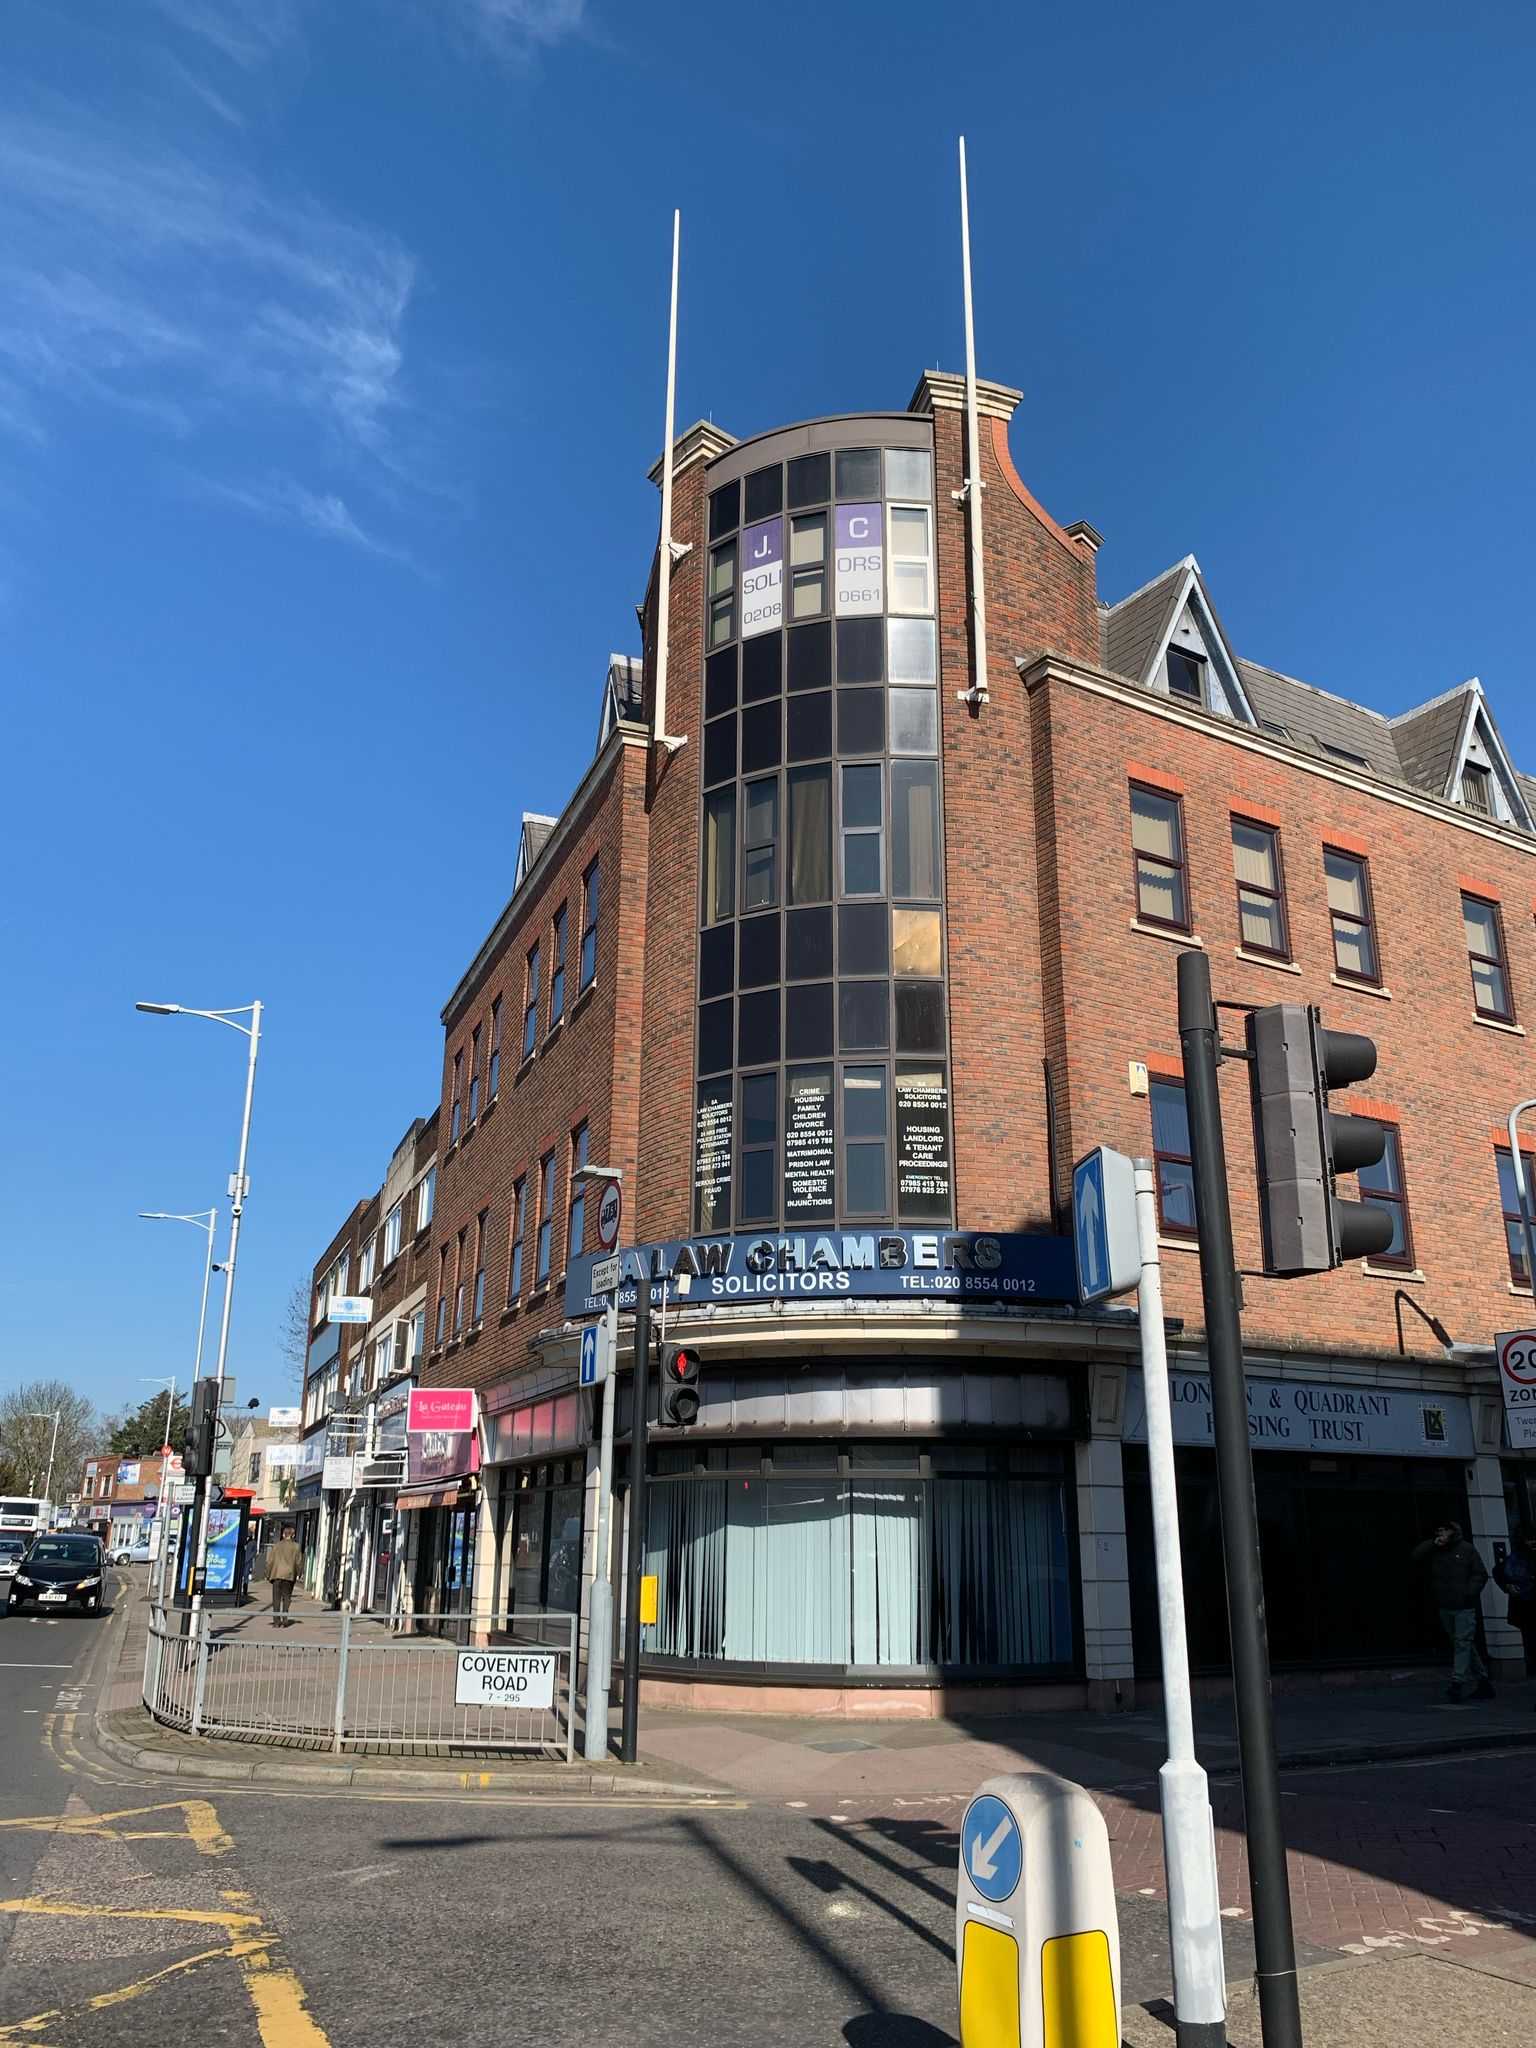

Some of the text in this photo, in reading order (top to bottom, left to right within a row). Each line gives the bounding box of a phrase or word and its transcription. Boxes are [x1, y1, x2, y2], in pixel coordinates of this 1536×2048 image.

[849, 517, 868, 538] C
[754, 535, 772, 558] J.
[837, 555, 881, 573] ORS
[742, 588, 880, 625] 0208 0661
[797, 1104, 821, 1112] FAMILY
[792, 1112, 826, 1120] CHILDREN
[794, 1121, 825, 1129] DIVORCE
[906, 1125, 940, 1133] HOUSING
[800, 1130, 816, 1138] 8554
[816, 1129, 833, 1137] 0012
[786, 1148, 834, 1157] MATRIMONIAL
[912, 1152, 934, 1160] CARE
[788, 1159, 831, 1168] PRISON LAW
[898, 1160, 948, 1168] PROCEEDINGS
[784, 1169, 835, 1178] MENTAL HEALTH
[792, 1179, 827, 1187] DOMESTIC
[704, 1186, 721, 1194] FRAUD
[787, 1198, 833, 1207] INJUNCTIONS
[650, 1242, 735, 1280] LAW
[746, 1235, 1001, 1274] CHAMBERS
[593, 1262, 618, 1279] Except for
[712, 1271, 850, 1294] SOLICITORS
[900, 1275, 1036, 1292] TEL:020 8554 0012
[619, 1289, 638, 1304] 855
[1269, 1387, 1281, 1409] &
[1294, 1390, 1391, 1416] QUADRANT
[1206, 1411, 1364, 1441] HSING TRUST
[462, 1656, 550, 1674] COVENTRY
[482, 1675, 528, 1692] ROAD
[488, 1693, 493, 1701] 7
[504, 1693, 520, 1702] 295
